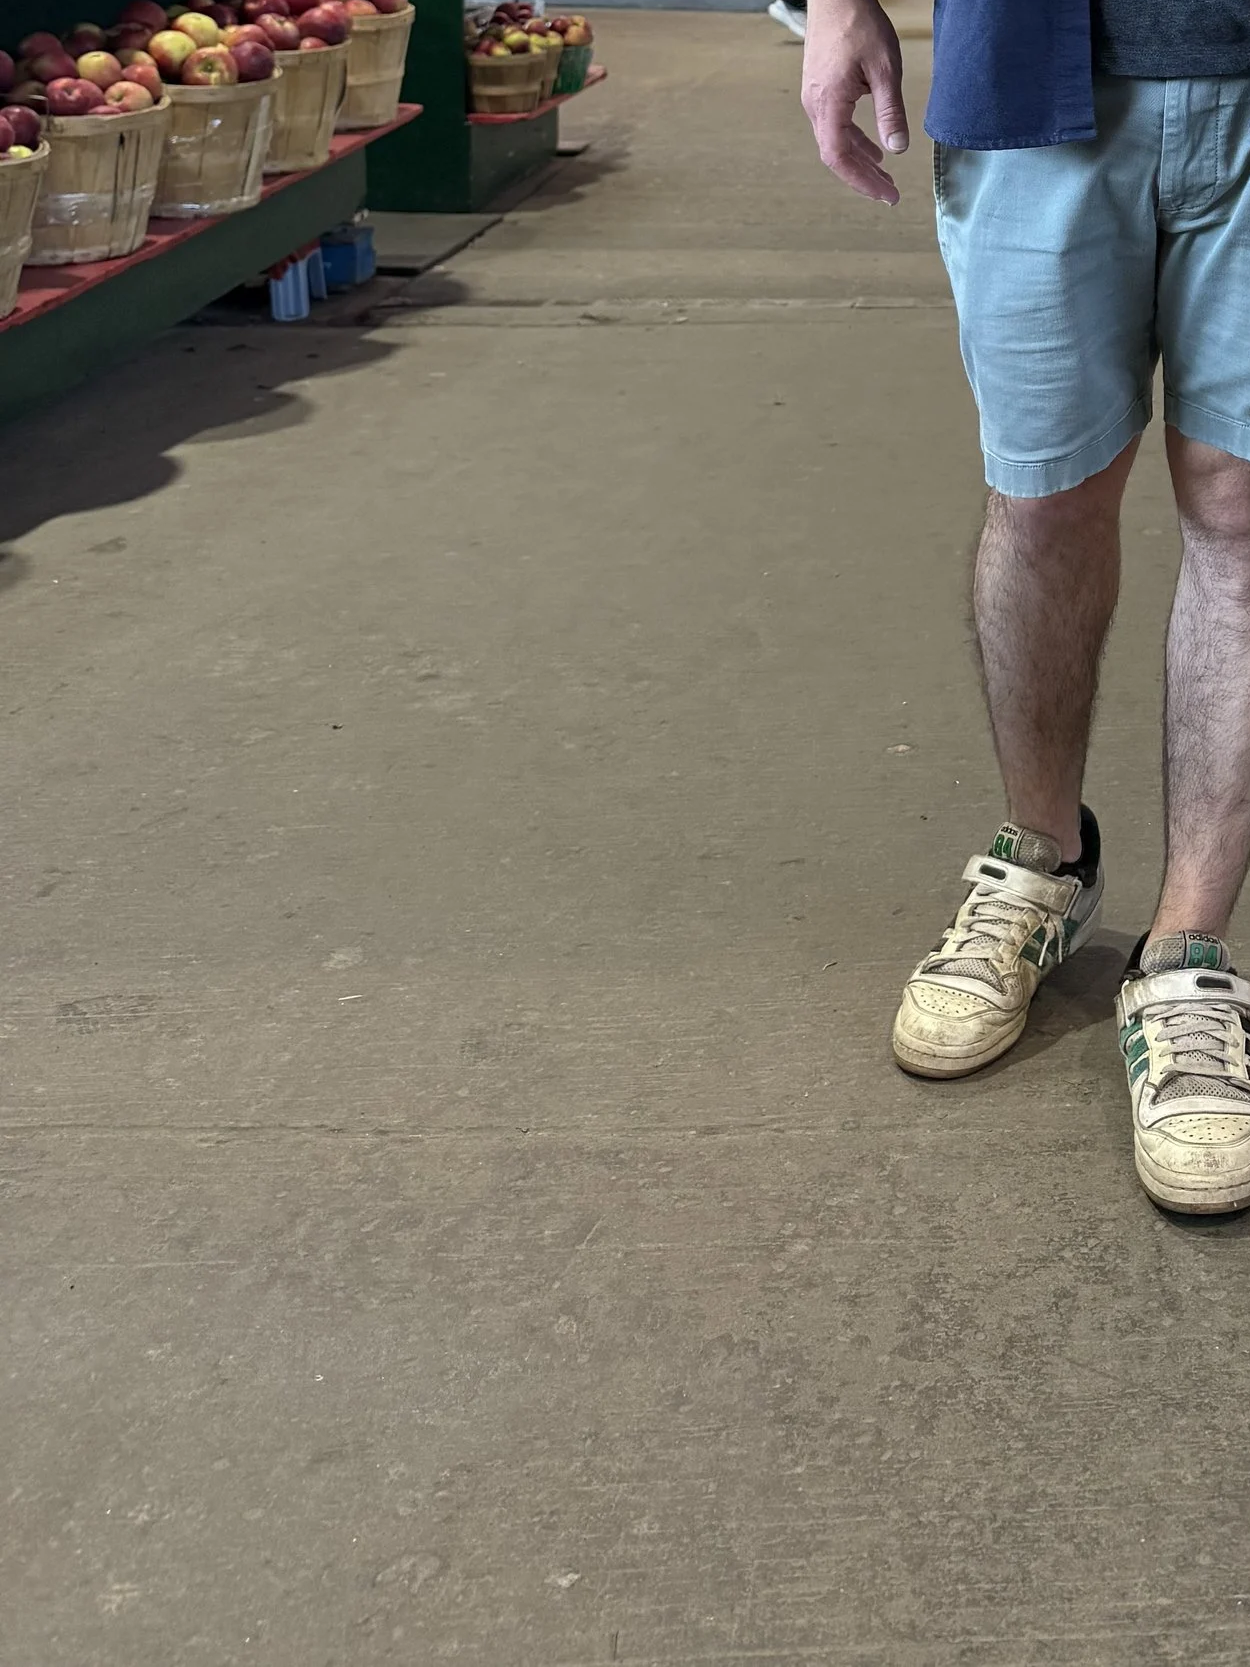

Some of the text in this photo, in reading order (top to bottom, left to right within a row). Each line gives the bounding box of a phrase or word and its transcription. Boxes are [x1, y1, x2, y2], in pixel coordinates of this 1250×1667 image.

[994, 833, 1014, 858] 84
[1189, 934, 1218, 944] adidas
[1188, 942, 1218, 968] 84
